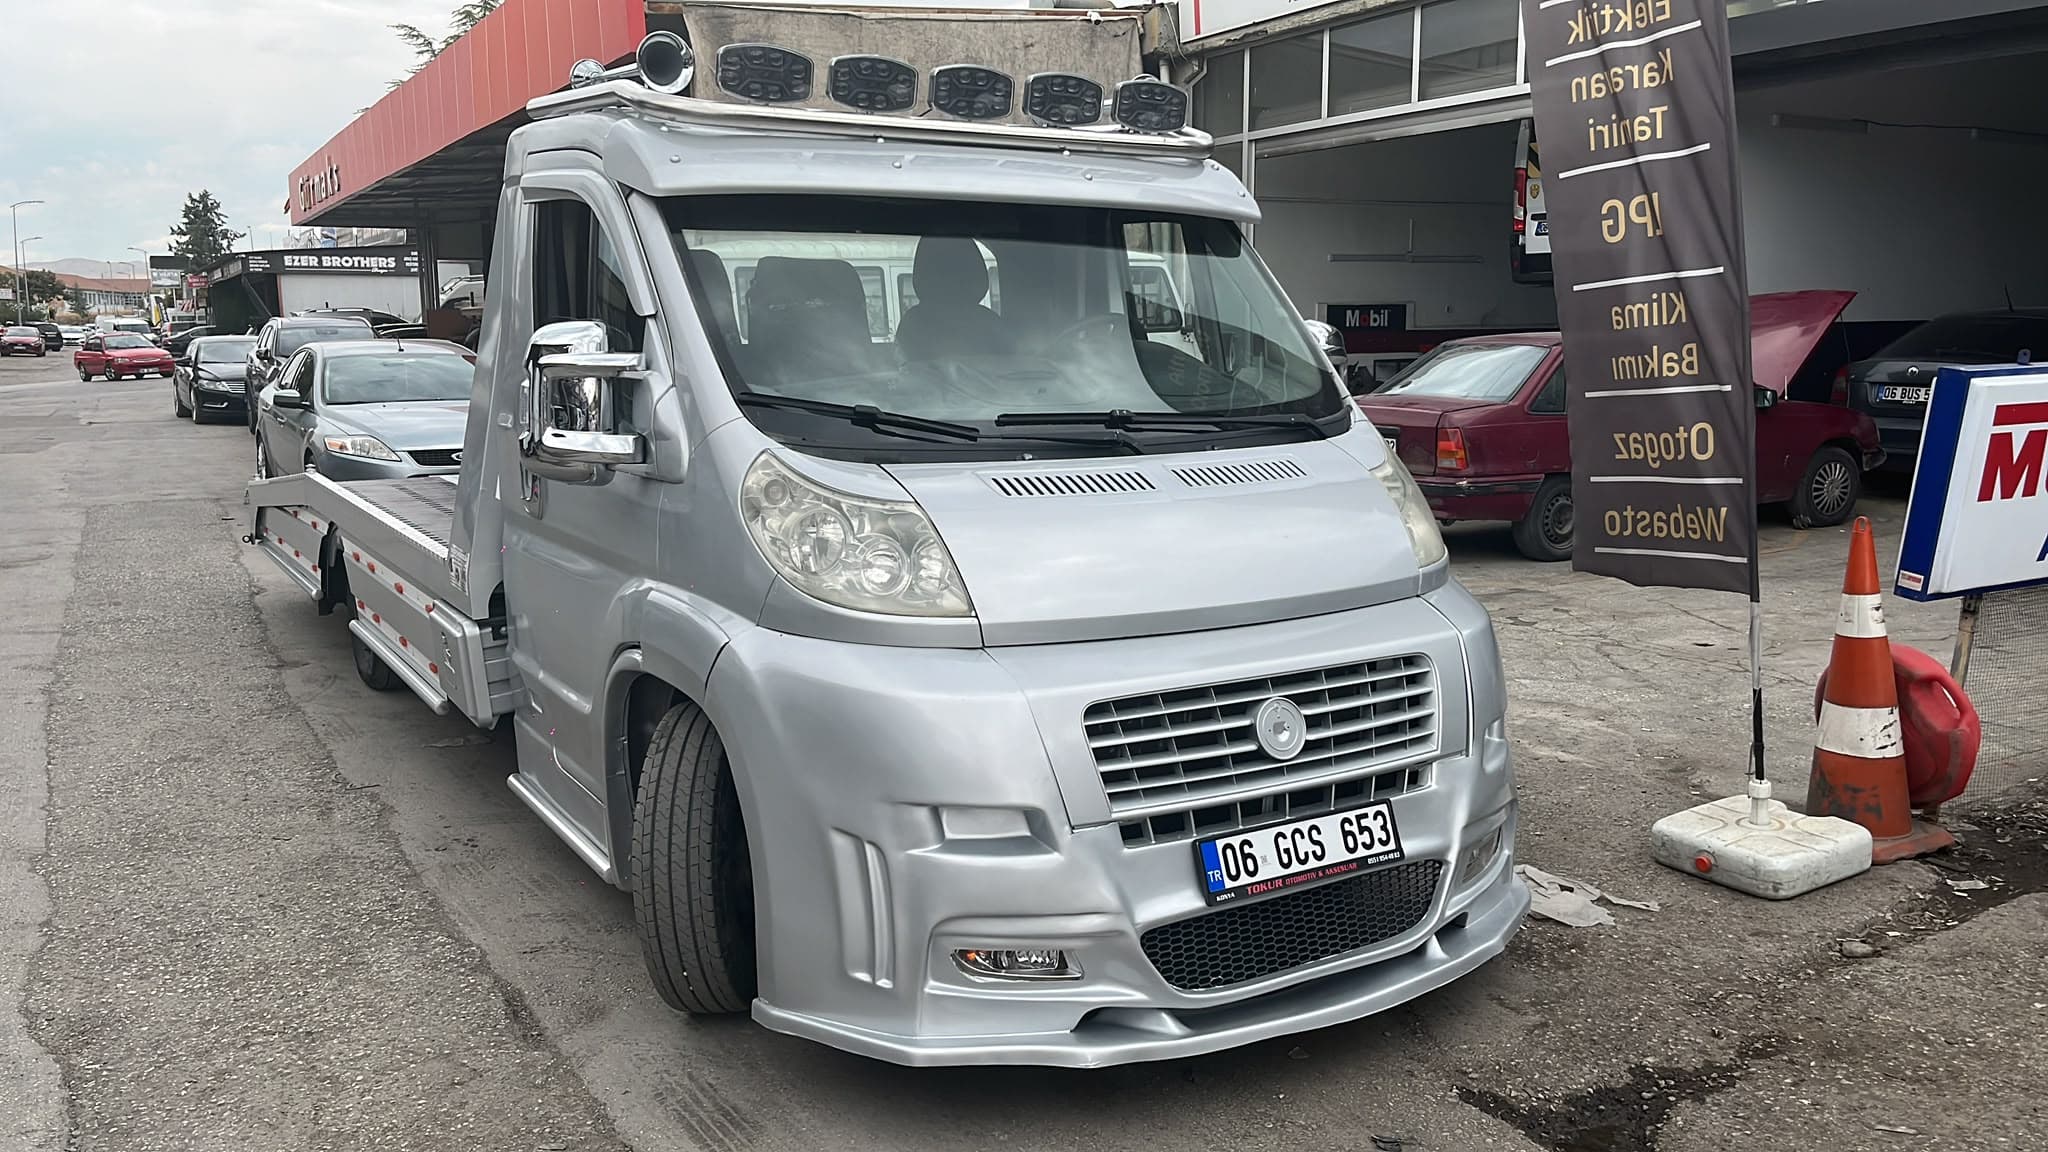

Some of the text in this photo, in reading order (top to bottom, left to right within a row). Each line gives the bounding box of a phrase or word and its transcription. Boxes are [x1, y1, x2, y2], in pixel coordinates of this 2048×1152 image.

[283, 255, 319, 267] EZER
[322, 255, 396, 268] BROTHERS
[1346, 309, 1389, 327] Mobil
[1884, 387, 1898, 399] 06
[1900, 387, 1921, 400] BUS
[1977, 429, 2048, 503] M
[1207, 809, 1391, 883] TR 06 GCS 653
[1247, 879, 1283, 895] TOKUR
